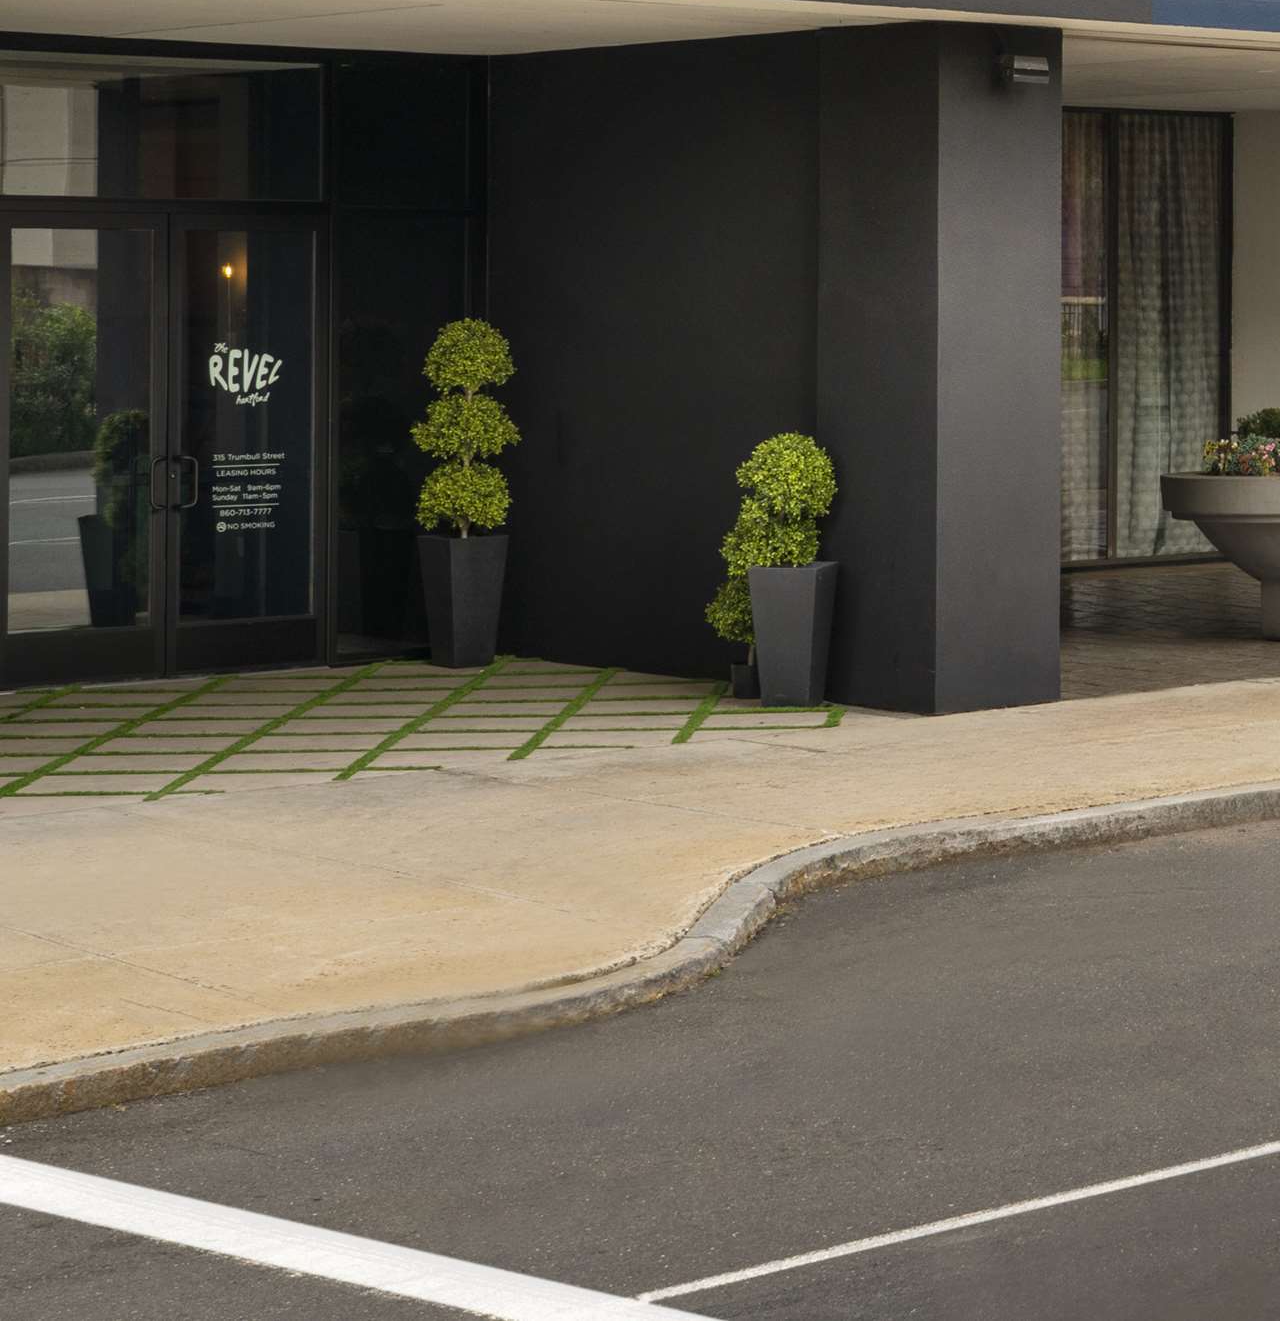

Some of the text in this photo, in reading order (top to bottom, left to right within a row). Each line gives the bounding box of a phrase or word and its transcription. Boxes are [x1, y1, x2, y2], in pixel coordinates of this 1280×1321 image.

[208, 348, 283, 393] REVEL
[262, 452, 285, 460] Street
[216, 468, 277, 477] LEASING HOURS
[211, 494, 239, 502] Sunday
[227, 521, 276, 530] NO SMOKING
